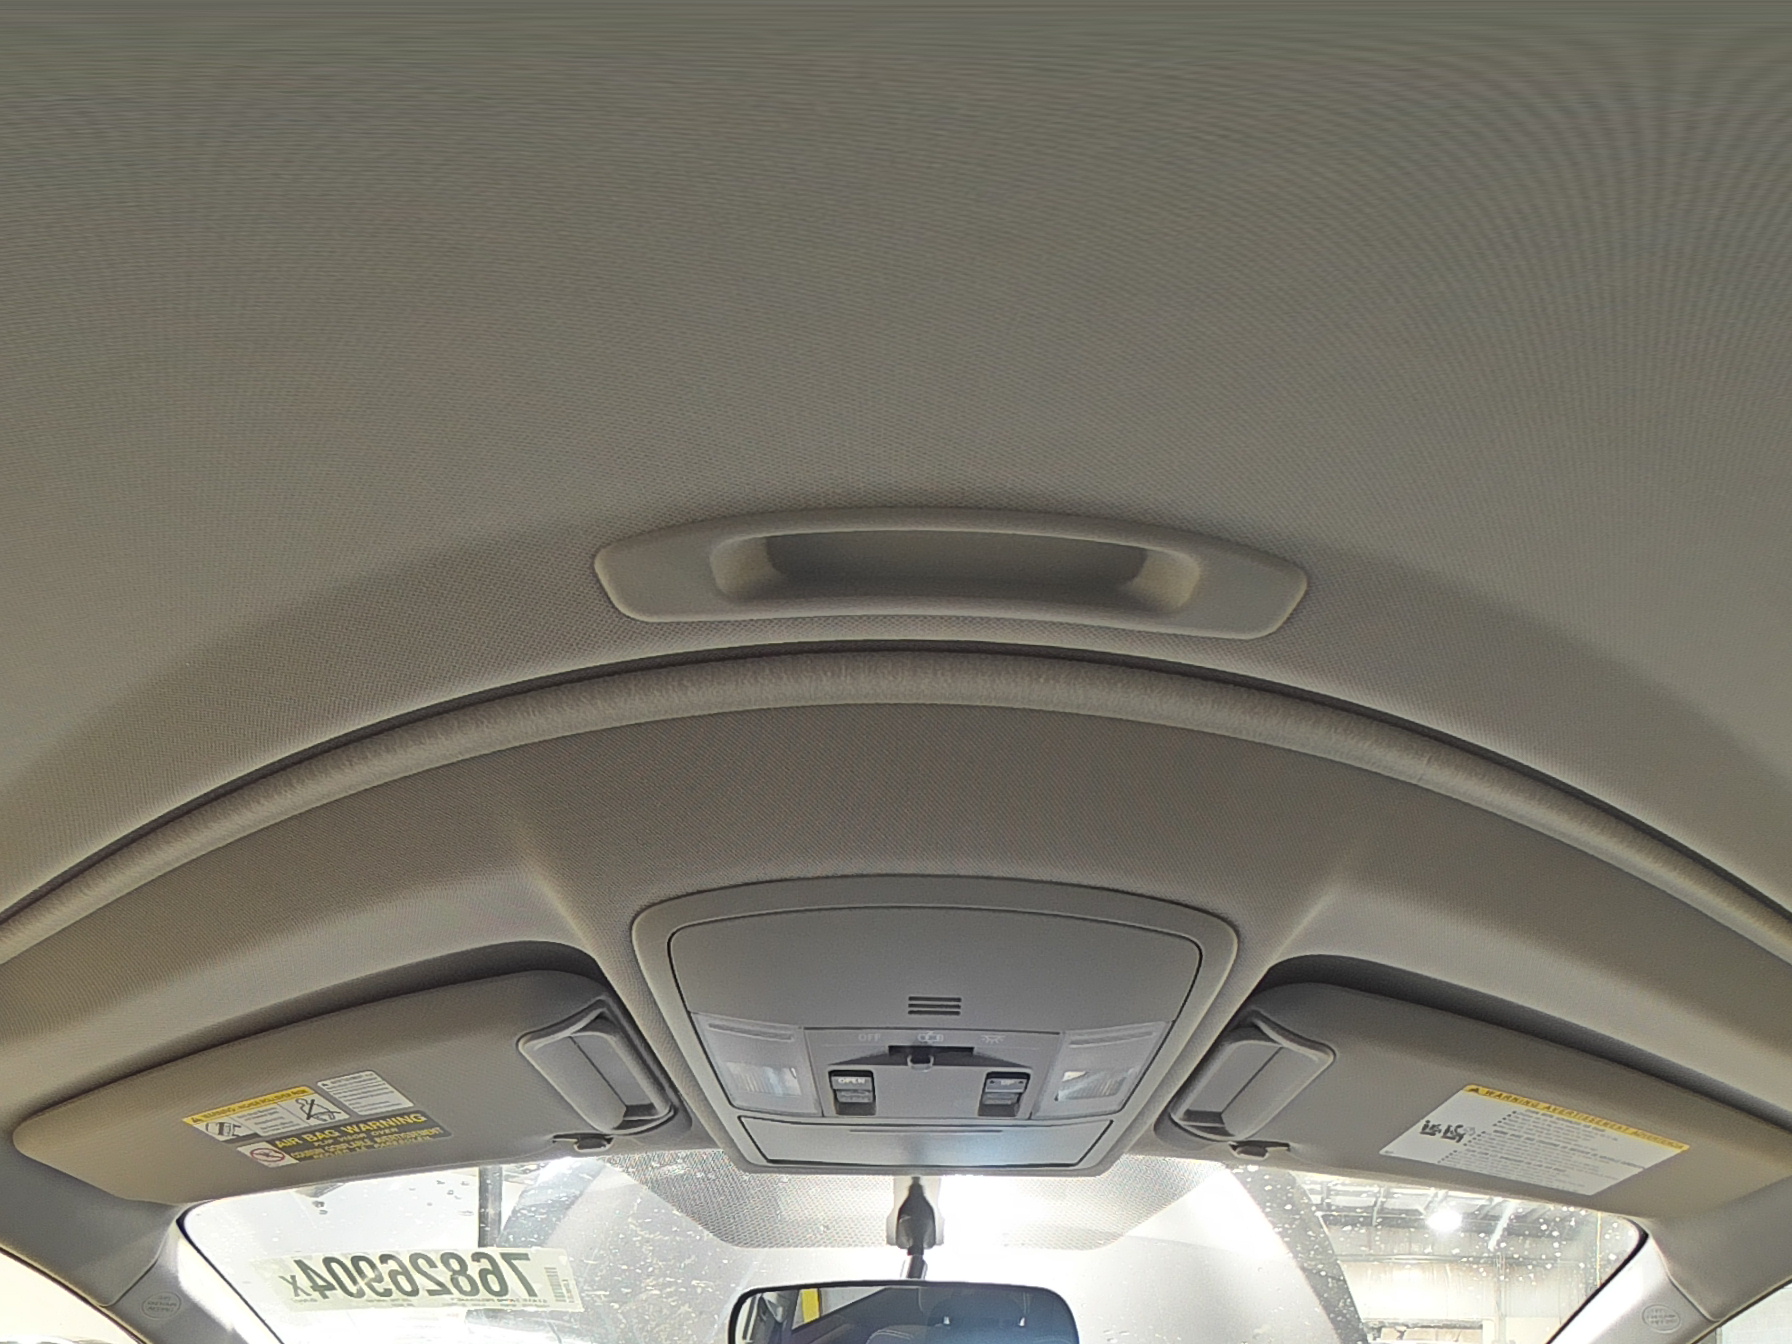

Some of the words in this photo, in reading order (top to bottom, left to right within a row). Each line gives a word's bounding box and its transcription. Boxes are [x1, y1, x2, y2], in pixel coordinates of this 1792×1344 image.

[273, 1136, 304, 1150] AIR
[306, 1128, 340, 1142] BAG
[344, 1113, 428, 1134] WARNING
